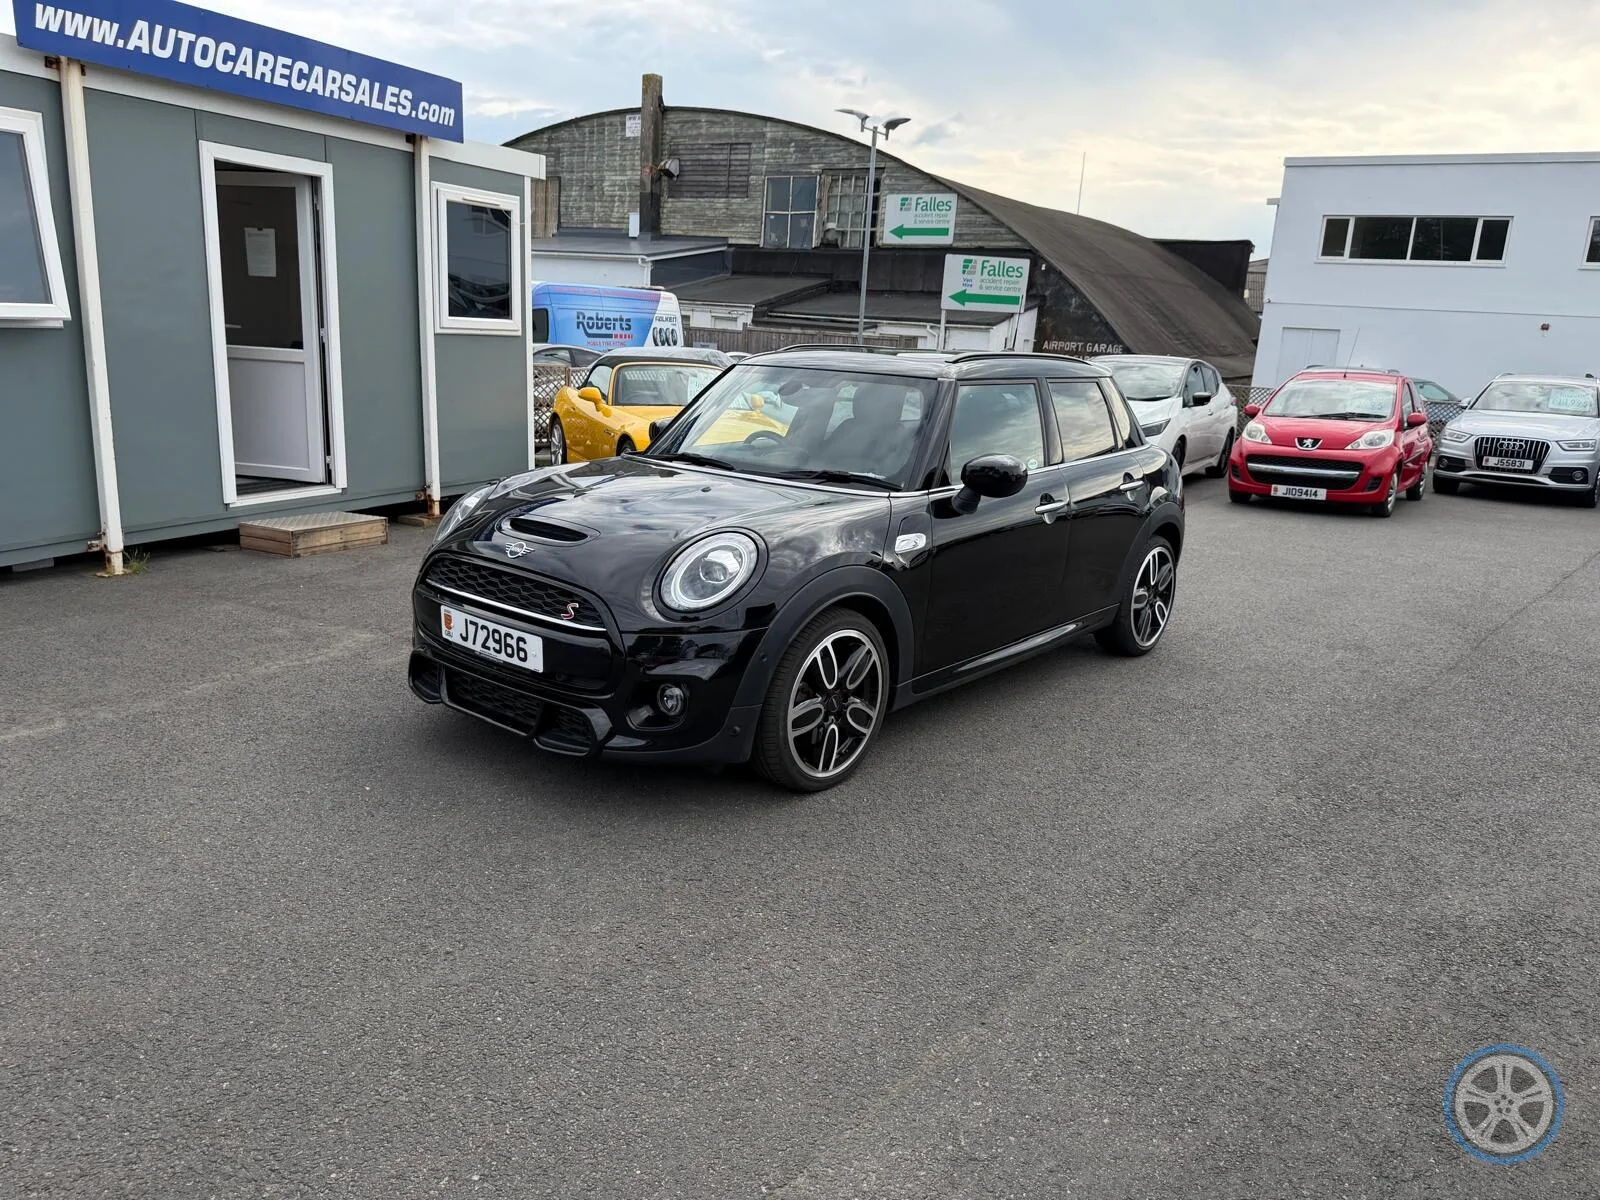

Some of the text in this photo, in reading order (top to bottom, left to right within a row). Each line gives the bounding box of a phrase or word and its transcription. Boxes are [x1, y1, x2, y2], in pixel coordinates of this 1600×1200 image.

[34, 2, 456, 127] www.AUTOCARECARSALES.com
[914, 196, 952, 212] Falles
[980, 259, 1024, 279] Falles
[576, 311, 632, 332] Roberts
[1042, 340, 1125, 354] AIRPORT GARAGE
[1493, 458, 1526, 468] J55831
[1282, 487, 1319, 499] J109414
[459, 618, 528, 663] J72966
